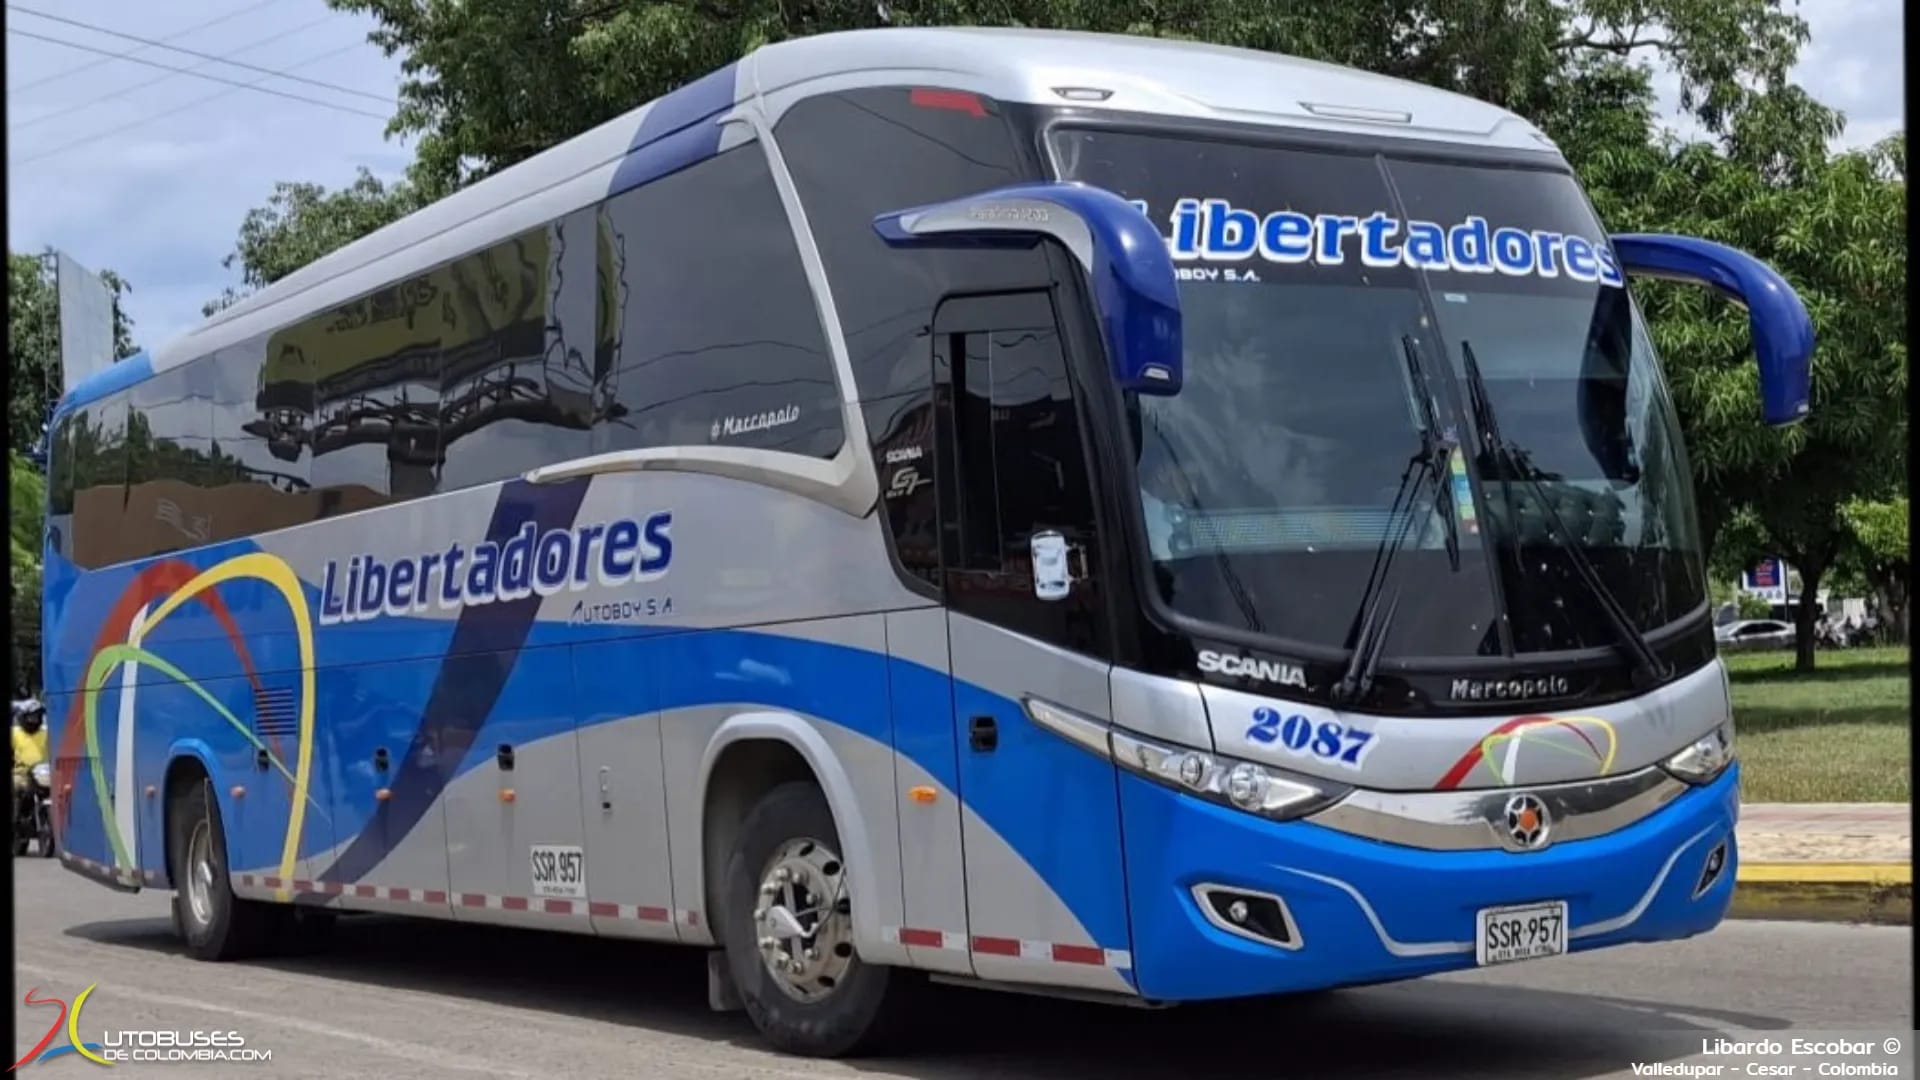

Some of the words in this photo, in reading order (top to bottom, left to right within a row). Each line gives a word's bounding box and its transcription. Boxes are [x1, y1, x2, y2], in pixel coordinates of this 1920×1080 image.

[1127, 198, 1625, 288] ibertadores
[722, 404, 800, 435] Marcopolo
[320, 509, 673, 626] Libertadores
[1197, 650, 1307, 689] SCANIA
[1450, 675, 1568, 700] Marcopolo
[1245, 706, 1378, 770] 2087
